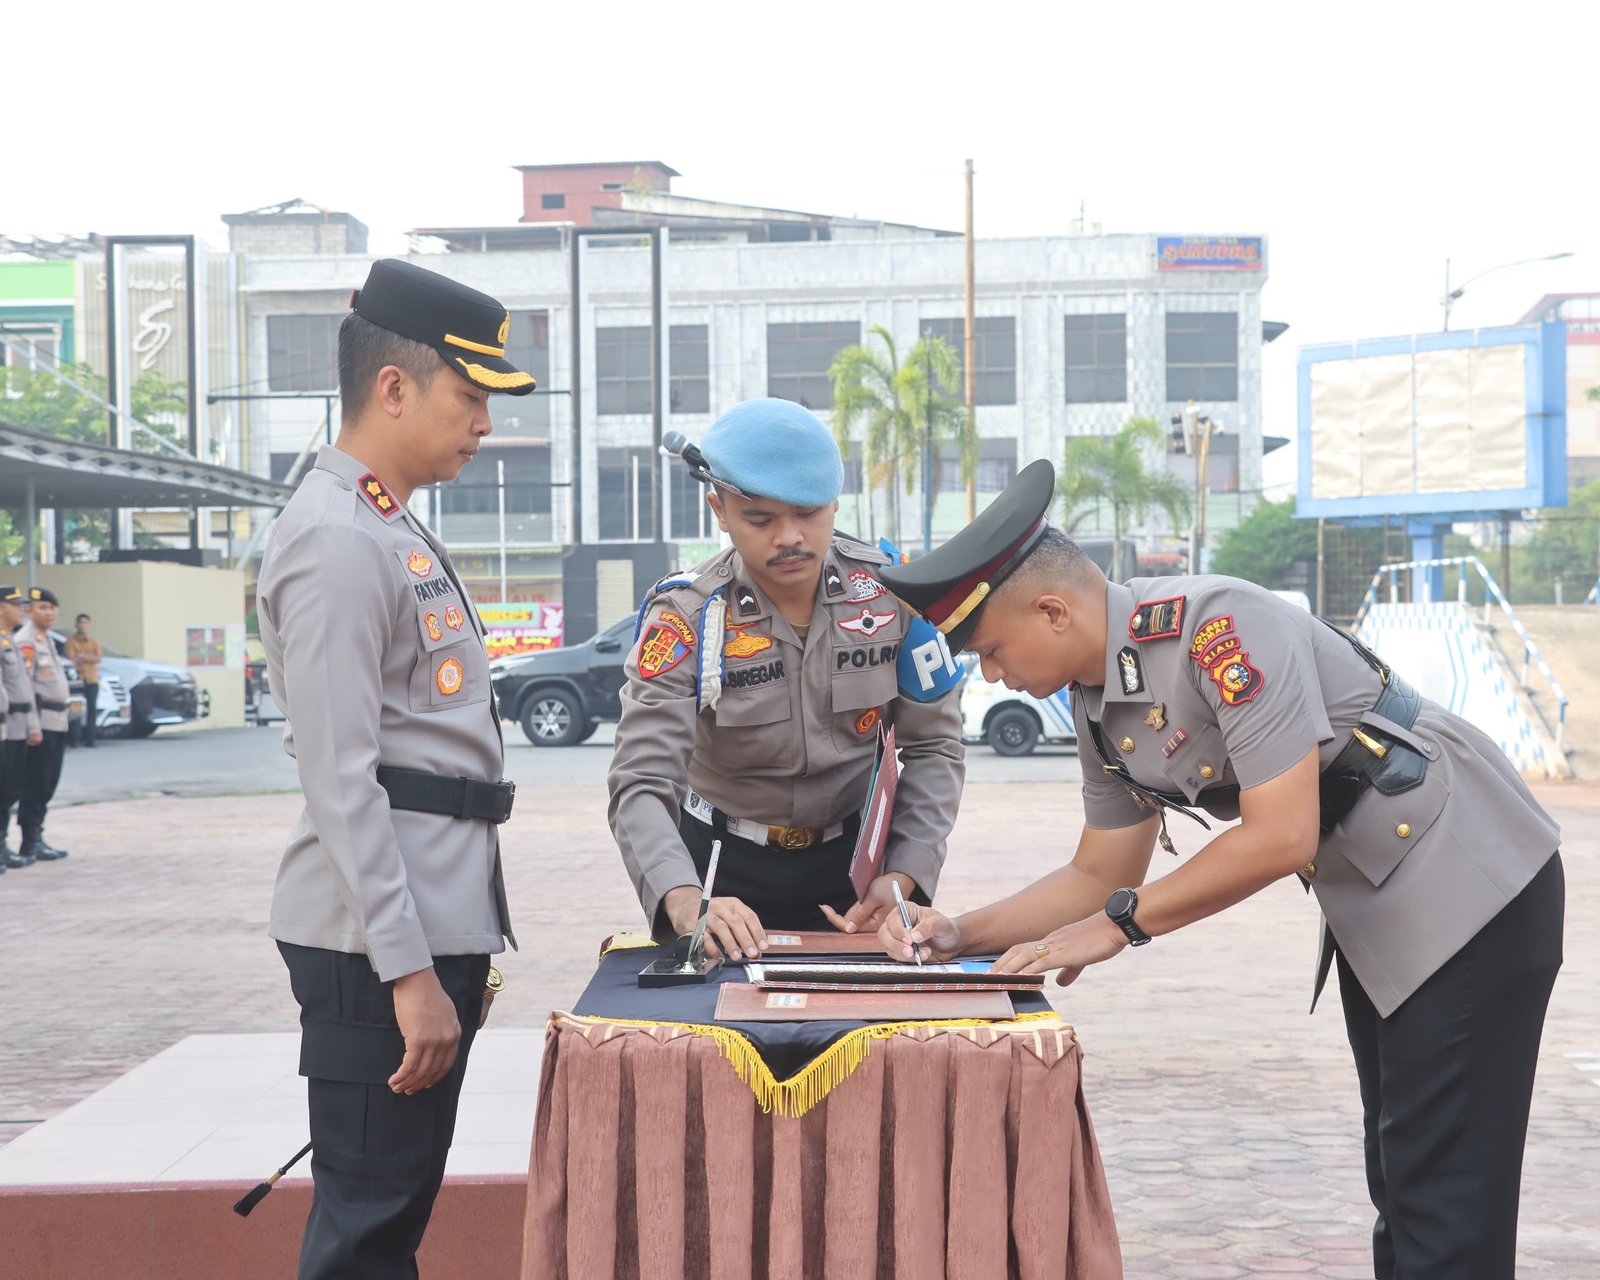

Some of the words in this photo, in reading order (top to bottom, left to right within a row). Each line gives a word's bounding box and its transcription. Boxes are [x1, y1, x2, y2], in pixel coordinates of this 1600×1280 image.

[414, 576, 454, 603] FATIKH
[661, 612, 693, 643] SIPROPAM
[1191, 619, 1228, 653] POLRES
[837, 643, 899, 670] POLRI
[1203, 640, 1235, 664] RIAU
